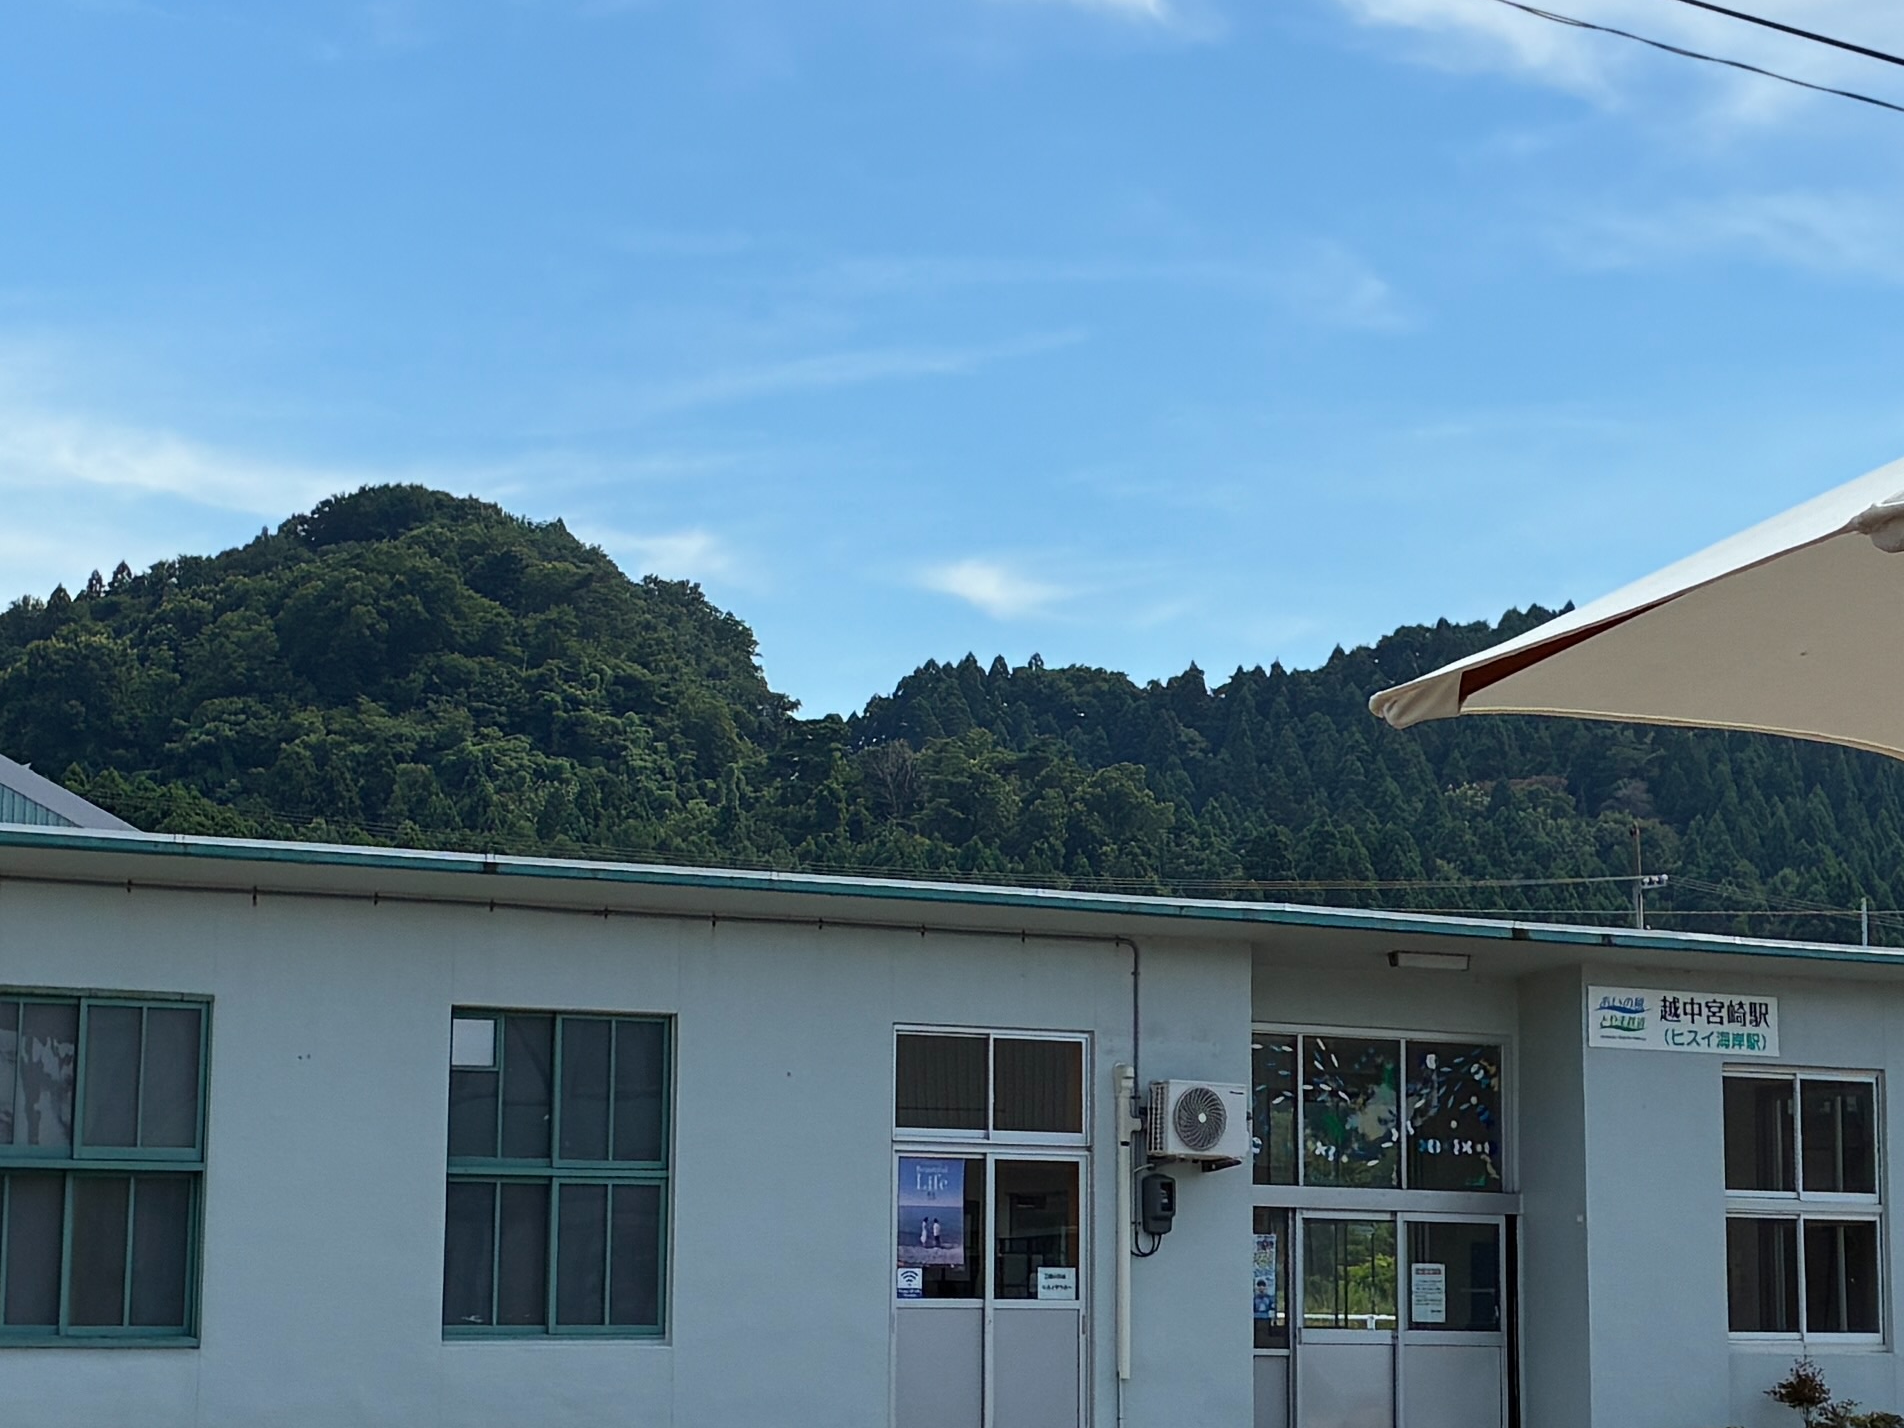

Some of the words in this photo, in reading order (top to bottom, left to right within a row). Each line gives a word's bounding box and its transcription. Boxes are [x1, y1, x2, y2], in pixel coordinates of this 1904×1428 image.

[1659, 995, 1771, 1028] 越中宮崎駅
